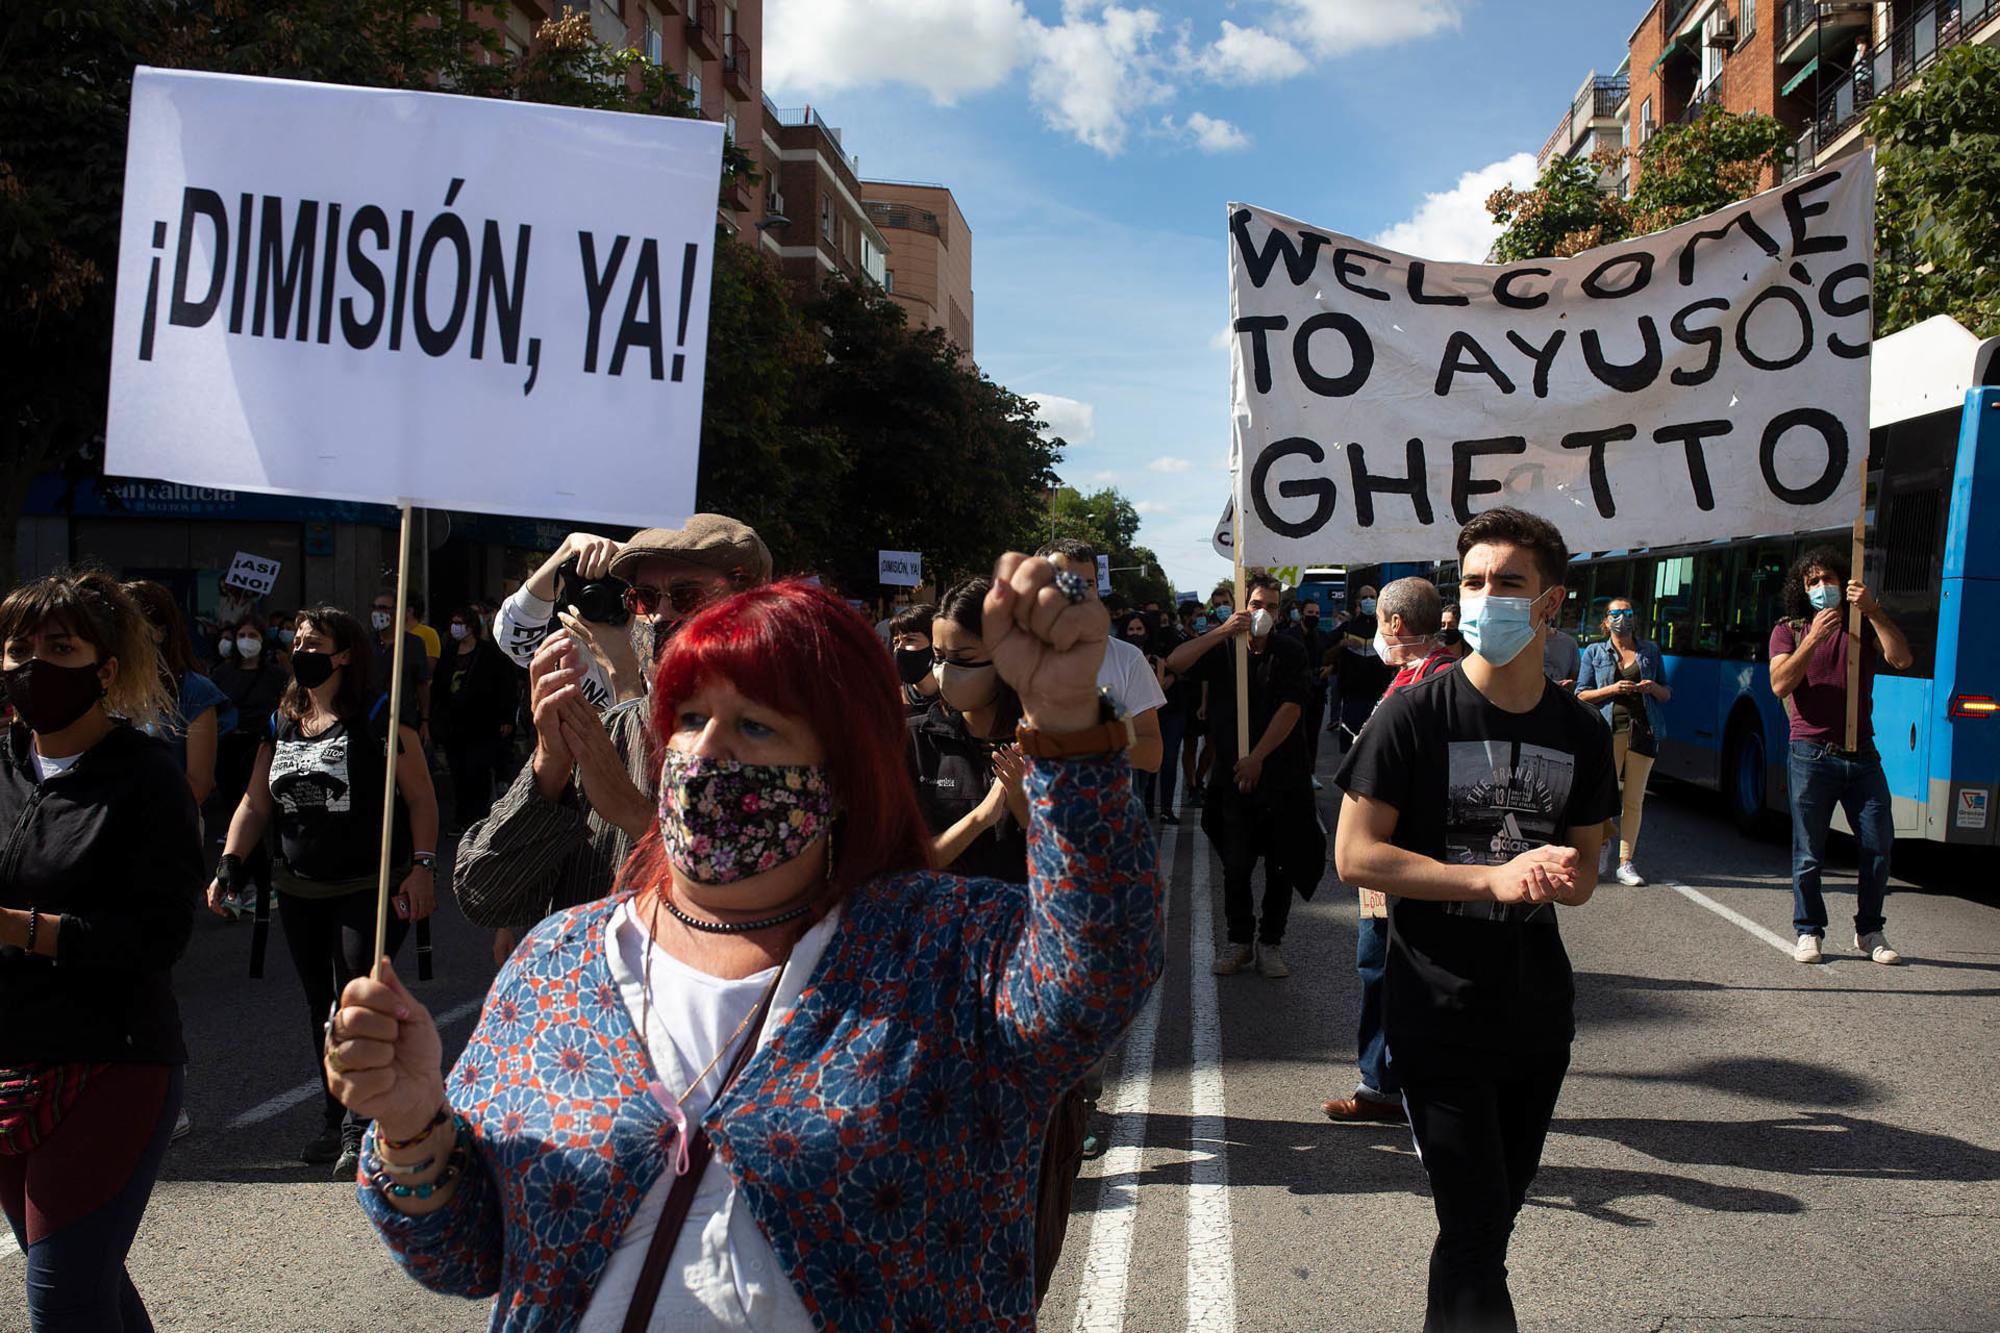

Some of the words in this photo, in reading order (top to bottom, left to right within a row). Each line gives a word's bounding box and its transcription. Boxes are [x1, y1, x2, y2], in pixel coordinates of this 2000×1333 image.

[1229, 171, 1848, 309] WELCOME
[138, 178, 541, 396] ¡DIMISIÓN,
[578, 230, 698, 383] YA!
[1234, 312, 1375, 398] TO
[1250, 407, 1849, 538] GHETTO
[232, 573, 269, 591] NO!
[323, 748, 344, 758] STOP
[1466, 779, 1491, 803] THE
[1535, 778, 1553, 813] WITH
